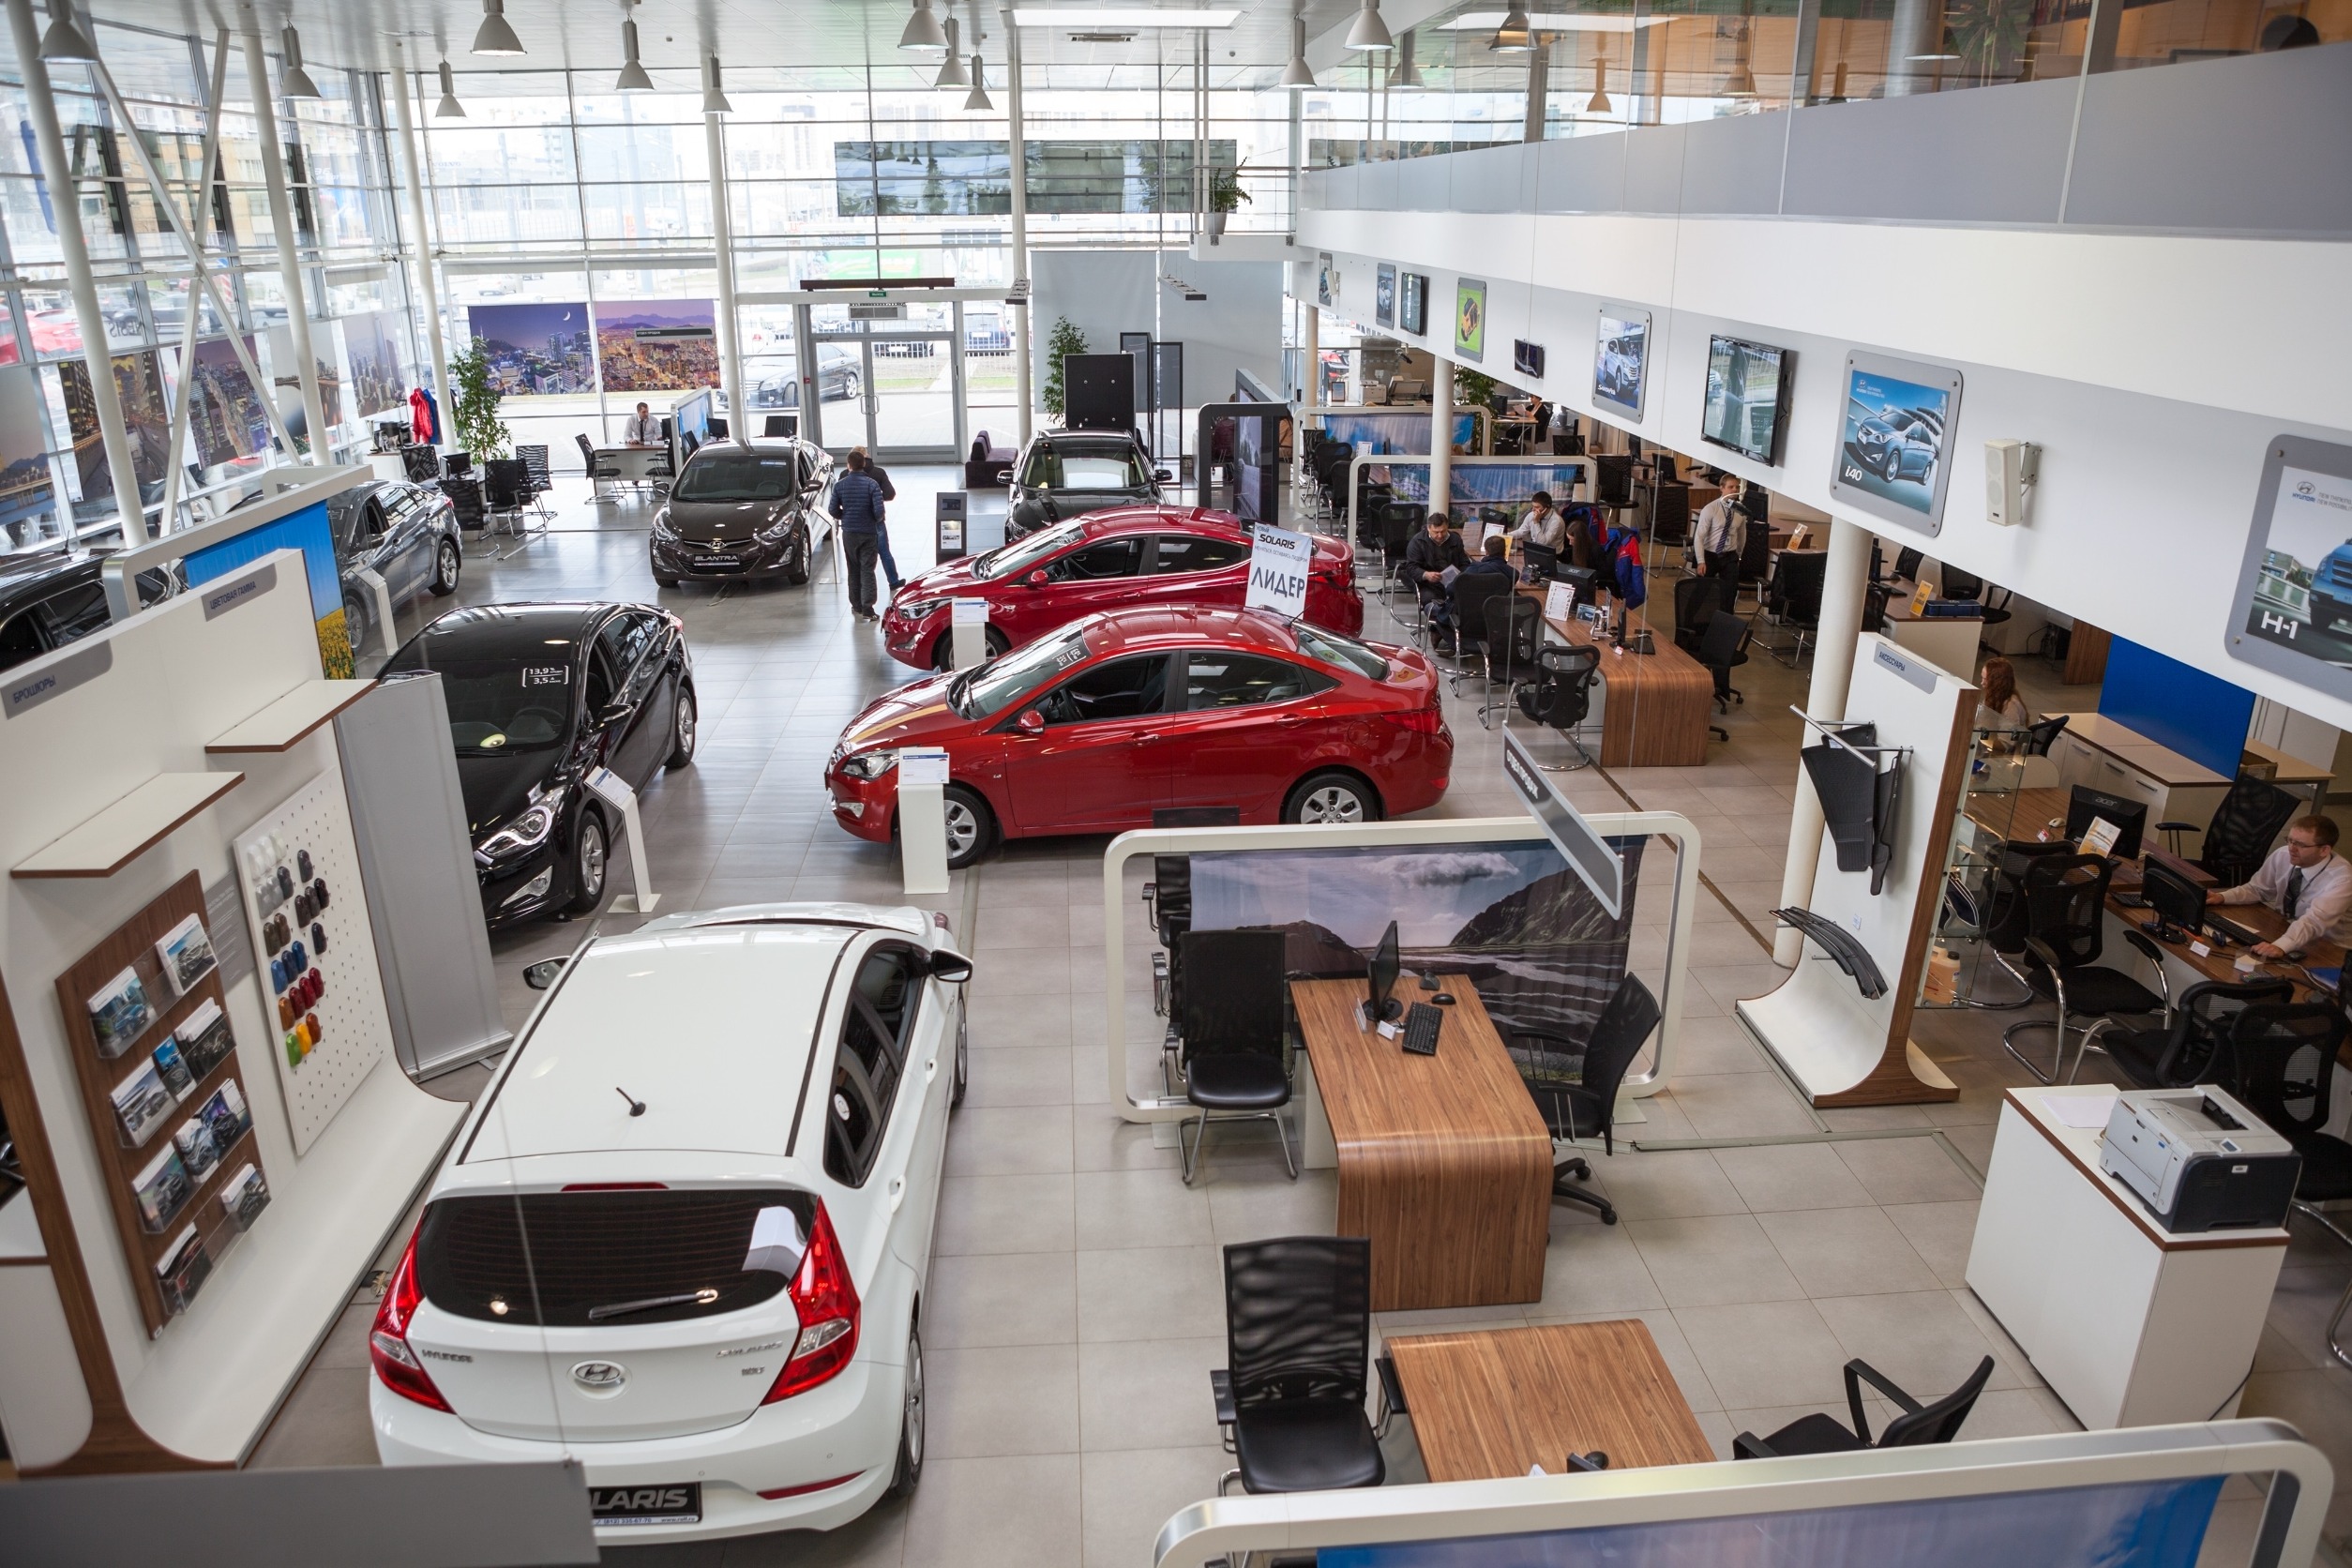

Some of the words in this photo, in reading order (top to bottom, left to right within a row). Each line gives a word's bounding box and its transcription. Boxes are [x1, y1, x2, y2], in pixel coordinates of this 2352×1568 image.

[1845, 464, 1862, 481] i40
[2292, 492, 2315, 504] HYUNDAI
[1258, 533, 1296, 550] SOLARIS
[1250, 566, 1305, 598] ЛИДЕР
[209, 590, 238, 610] ЦВЕТОВАЯ
[237, 580, 257, 597] ГАММА
[2260, 611, 2299, 640] H-1
[13, 674, 56, 704] БРОШЮРЫ
[2095, 796, 2118, 807] acer
[422, 1349, 474, 1364] HYUNDAI
[590, 1488, 688, 1510] LARIS
